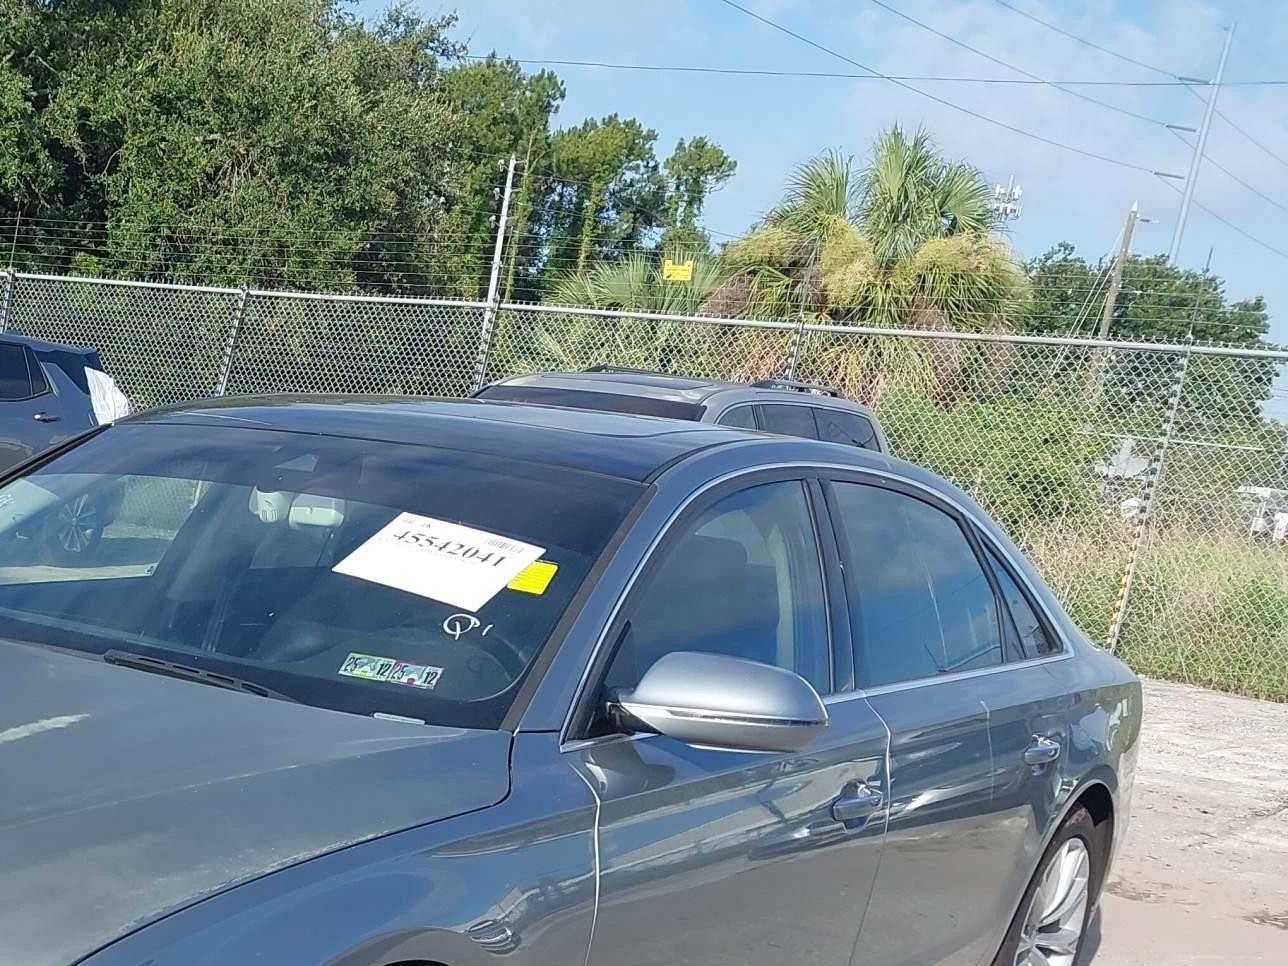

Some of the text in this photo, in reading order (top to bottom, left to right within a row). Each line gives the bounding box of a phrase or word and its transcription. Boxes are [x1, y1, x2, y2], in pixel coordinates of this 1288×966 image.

[393, 530, 507, 566] 45542041
[344, 656, 392, 677] 25 12
[391, 662, 439, 685] 25 12
